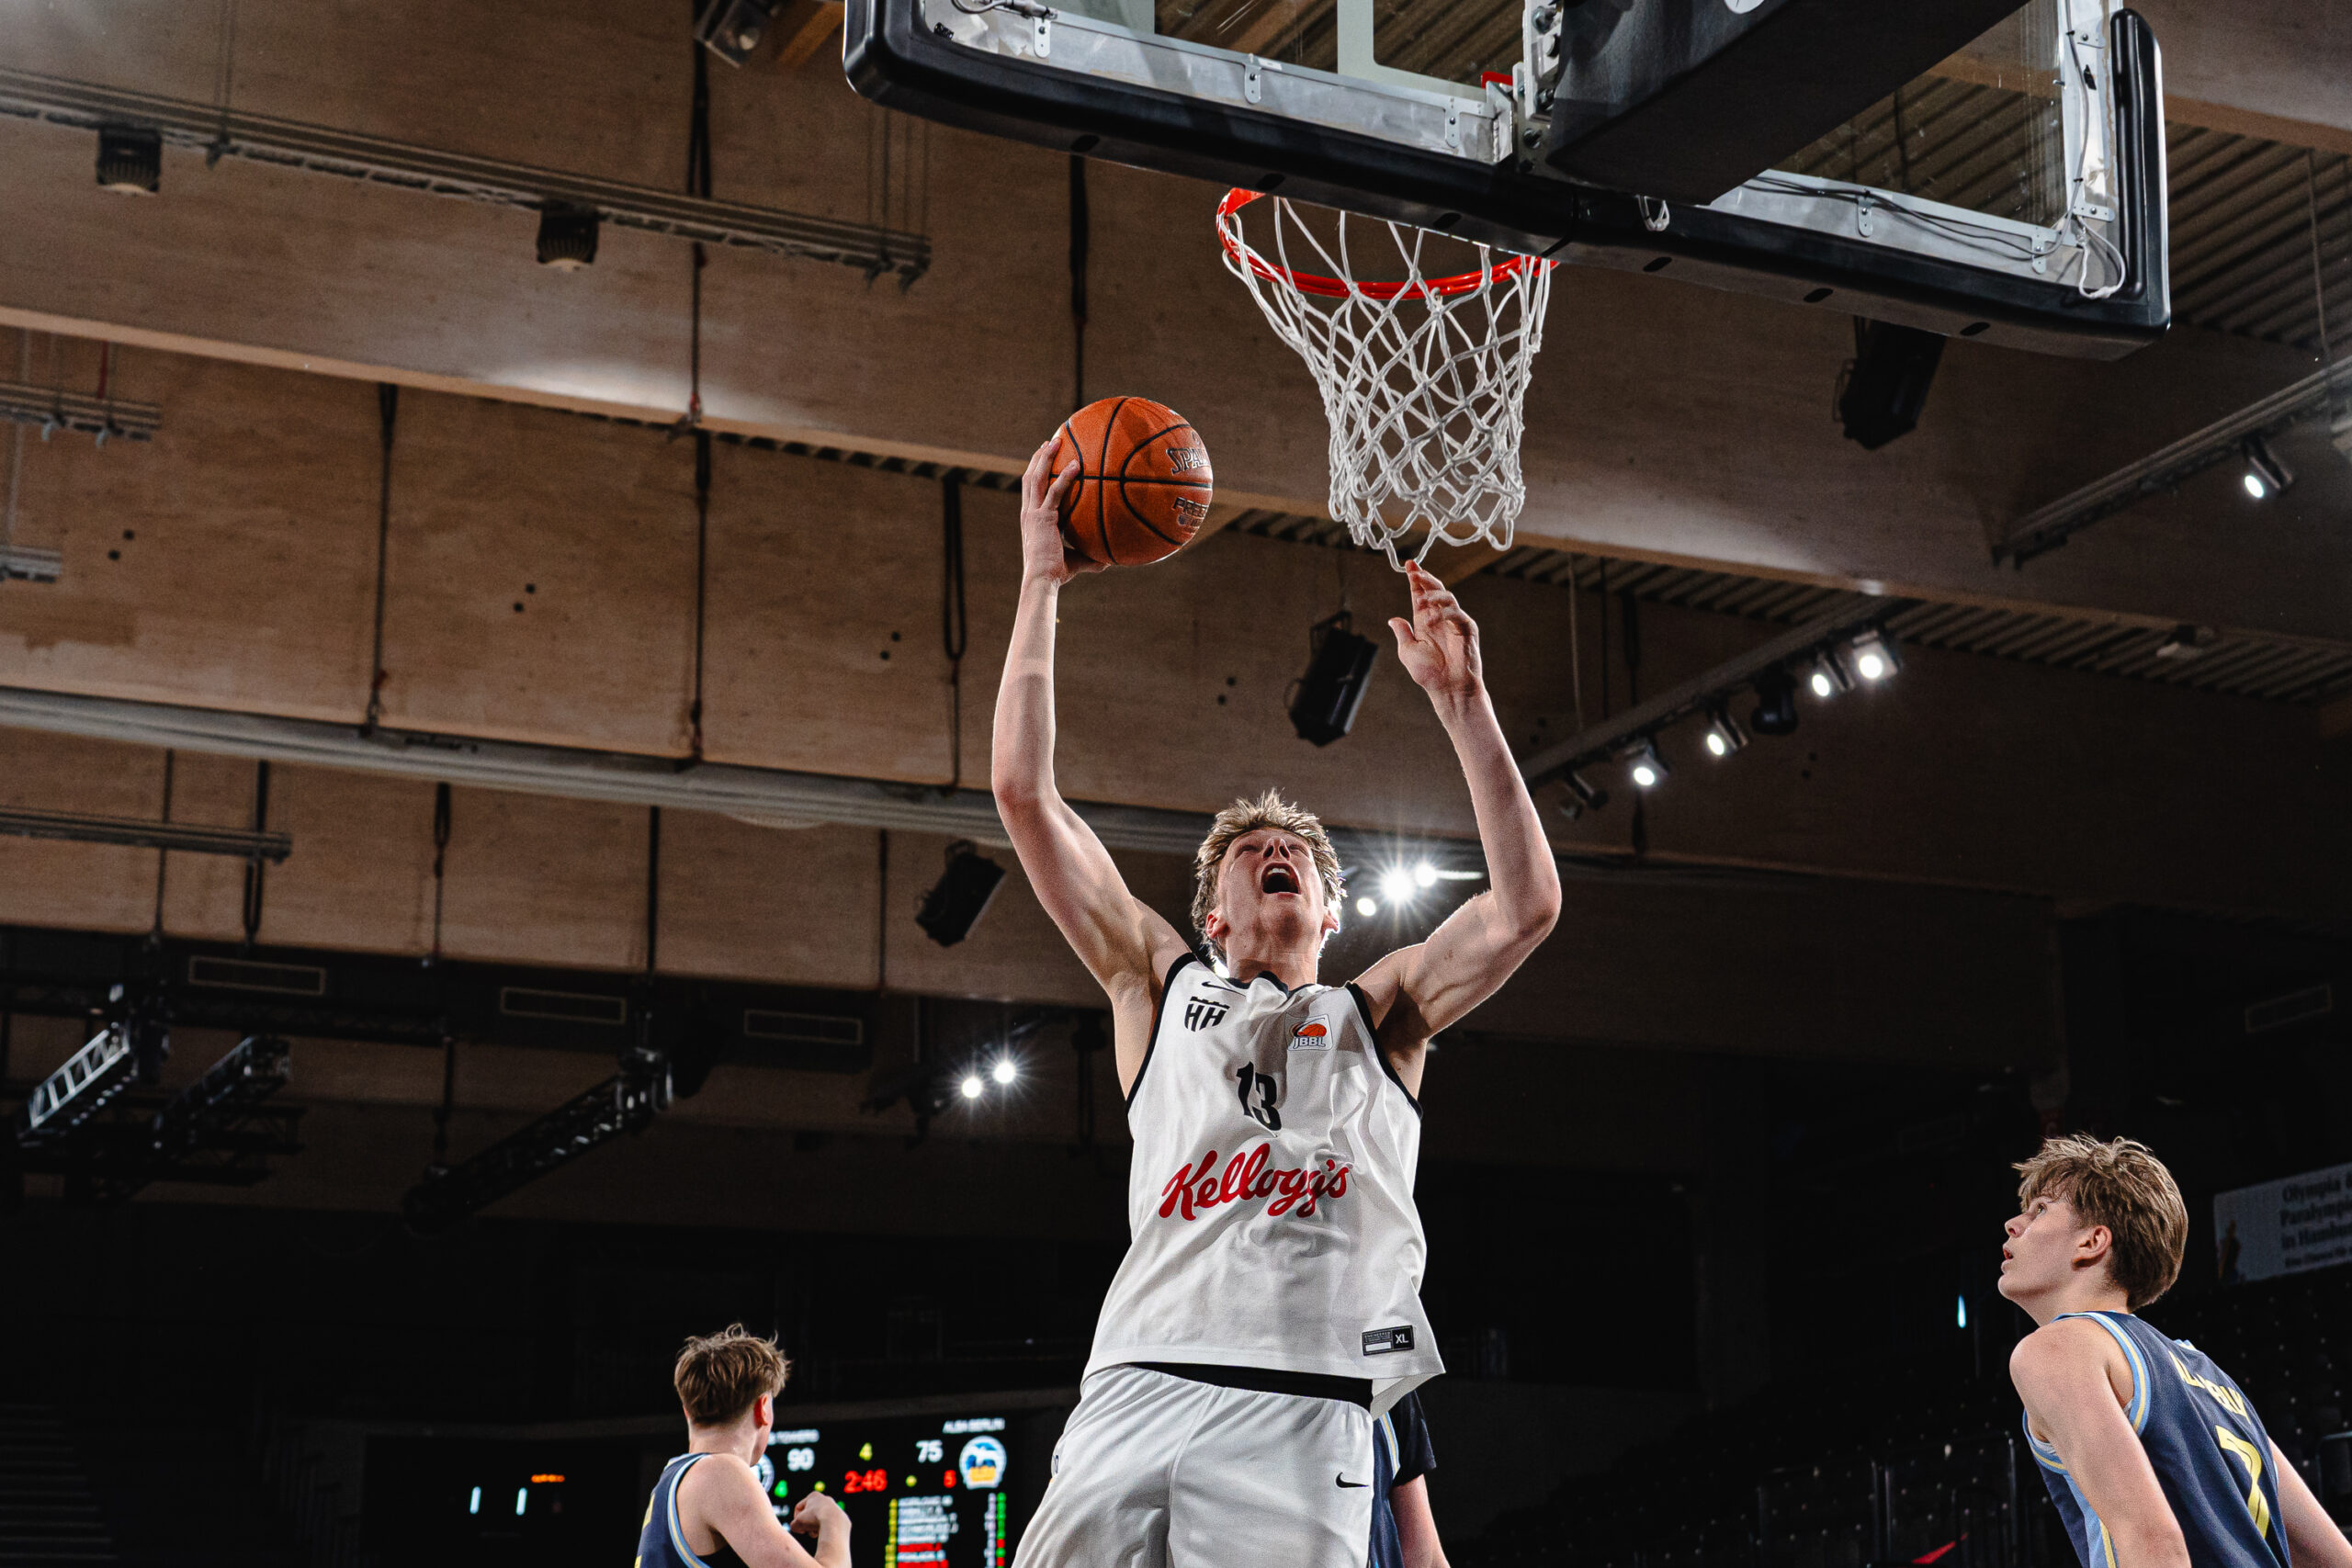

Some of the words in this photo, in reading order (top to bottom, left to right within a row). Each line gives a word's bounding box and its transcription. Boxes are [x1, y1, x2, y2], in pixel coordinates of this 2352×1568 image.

[1292, 1036, 1328, 1050] JBBL
[1235, 1061, 1283, 1131] 13
[1158, 1142, 1351, 1222] Kellogg's
[1395, 1334, 1408, 1344] XL
[859, 1442, 873, 1461] 4
[916, 1439, 944, 1463] 75
[843, 1468, 888, 1495] 2:46
[2215, 1425, 2269, 1540] 7
